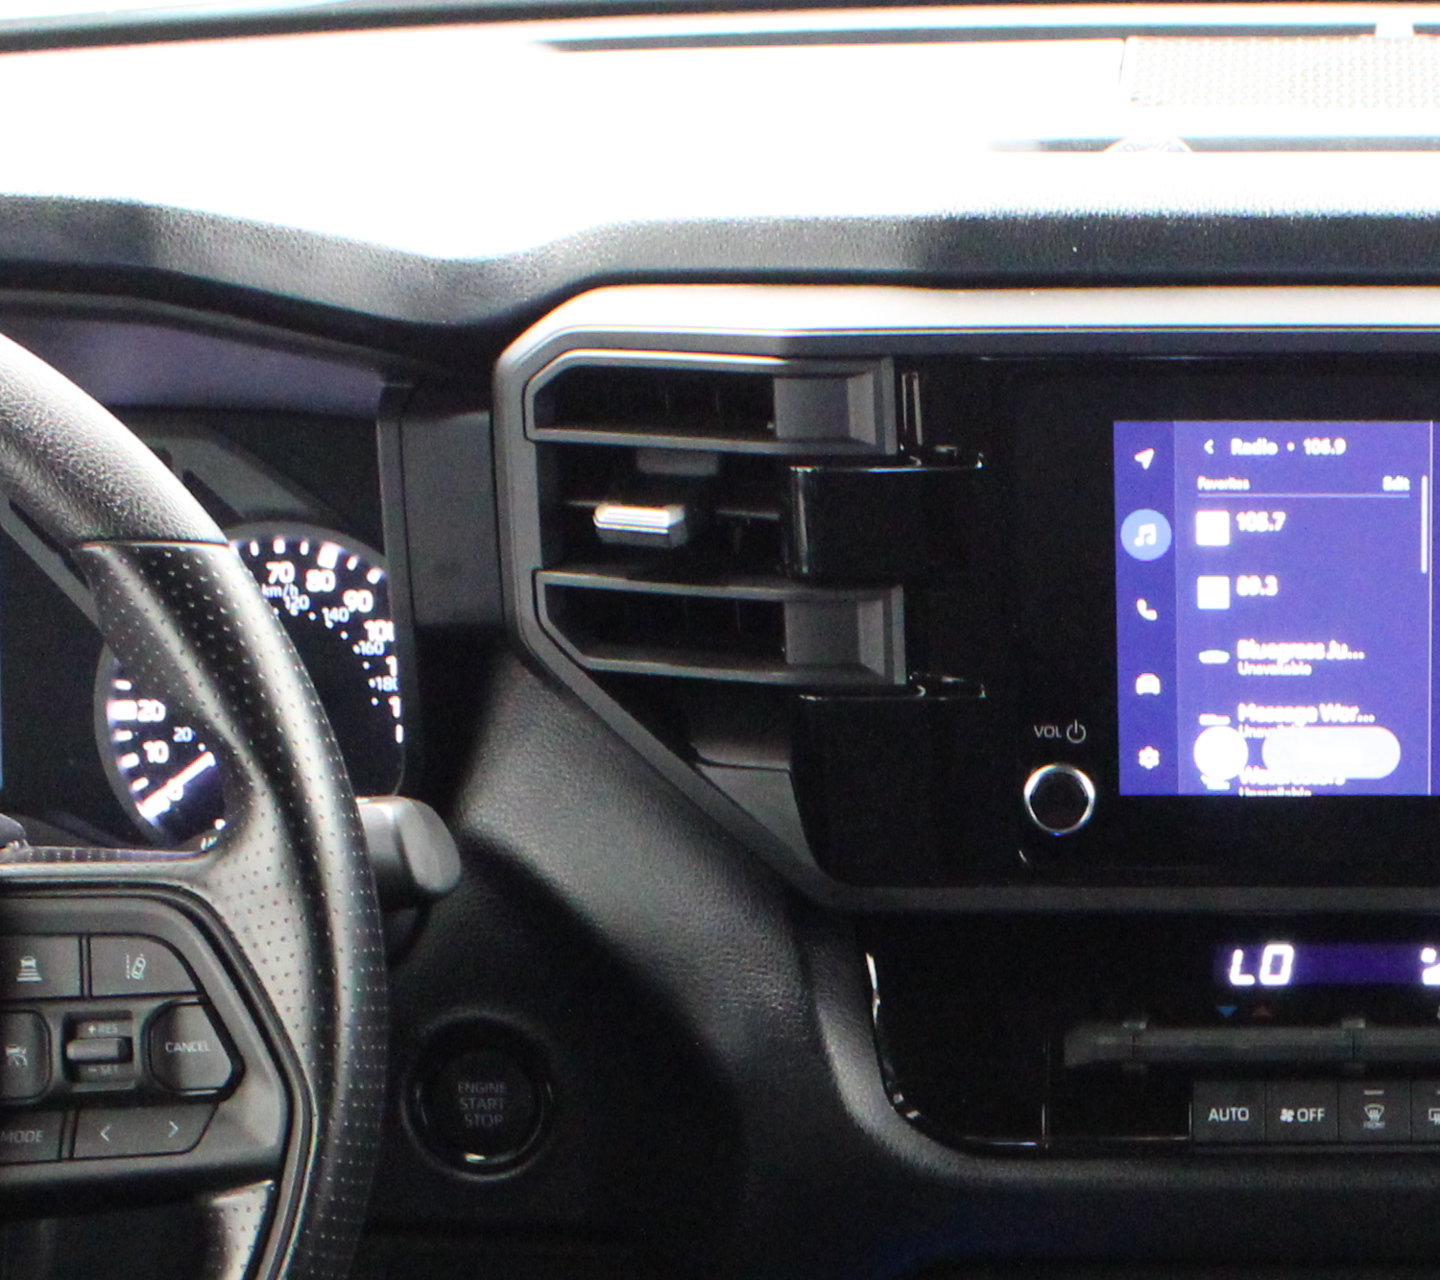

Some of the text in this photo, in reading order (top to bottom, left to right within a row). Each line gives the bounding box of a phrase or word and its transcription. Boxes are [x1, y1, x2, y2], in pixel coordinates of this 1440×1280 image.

[1231, 438, 1278, 455] Radio
[1382, 475, 1410, 491] Edit
[265, 561, 295, 585] 70
[305, 569, 336, 592] 80
[262, 584, 299, 598] km/h
[283, 595, 310, 611] 120
[343, 589, 374, 613] 90
[322, 607, 350, 623] 140
[358, 641, 384, 656] 160
[137, 699, 166, 723] 20
[173, 726, 194, 743] 20
[1034, 725, 1062, 738] VOL
[143, 740, 169, 764] 10
[1230, 944, 1294, 986] LO
[165, 1041, 210, 1053] CANCEL
[459, 1097, 505, 1110] START
[464, 1114, 504, 1128] STOP
[1208, 1108, 1249, 1121] AUTO
[1297, 1108, 1325, 1122] OFF
[0, 1130, 45, 1143] MODE
